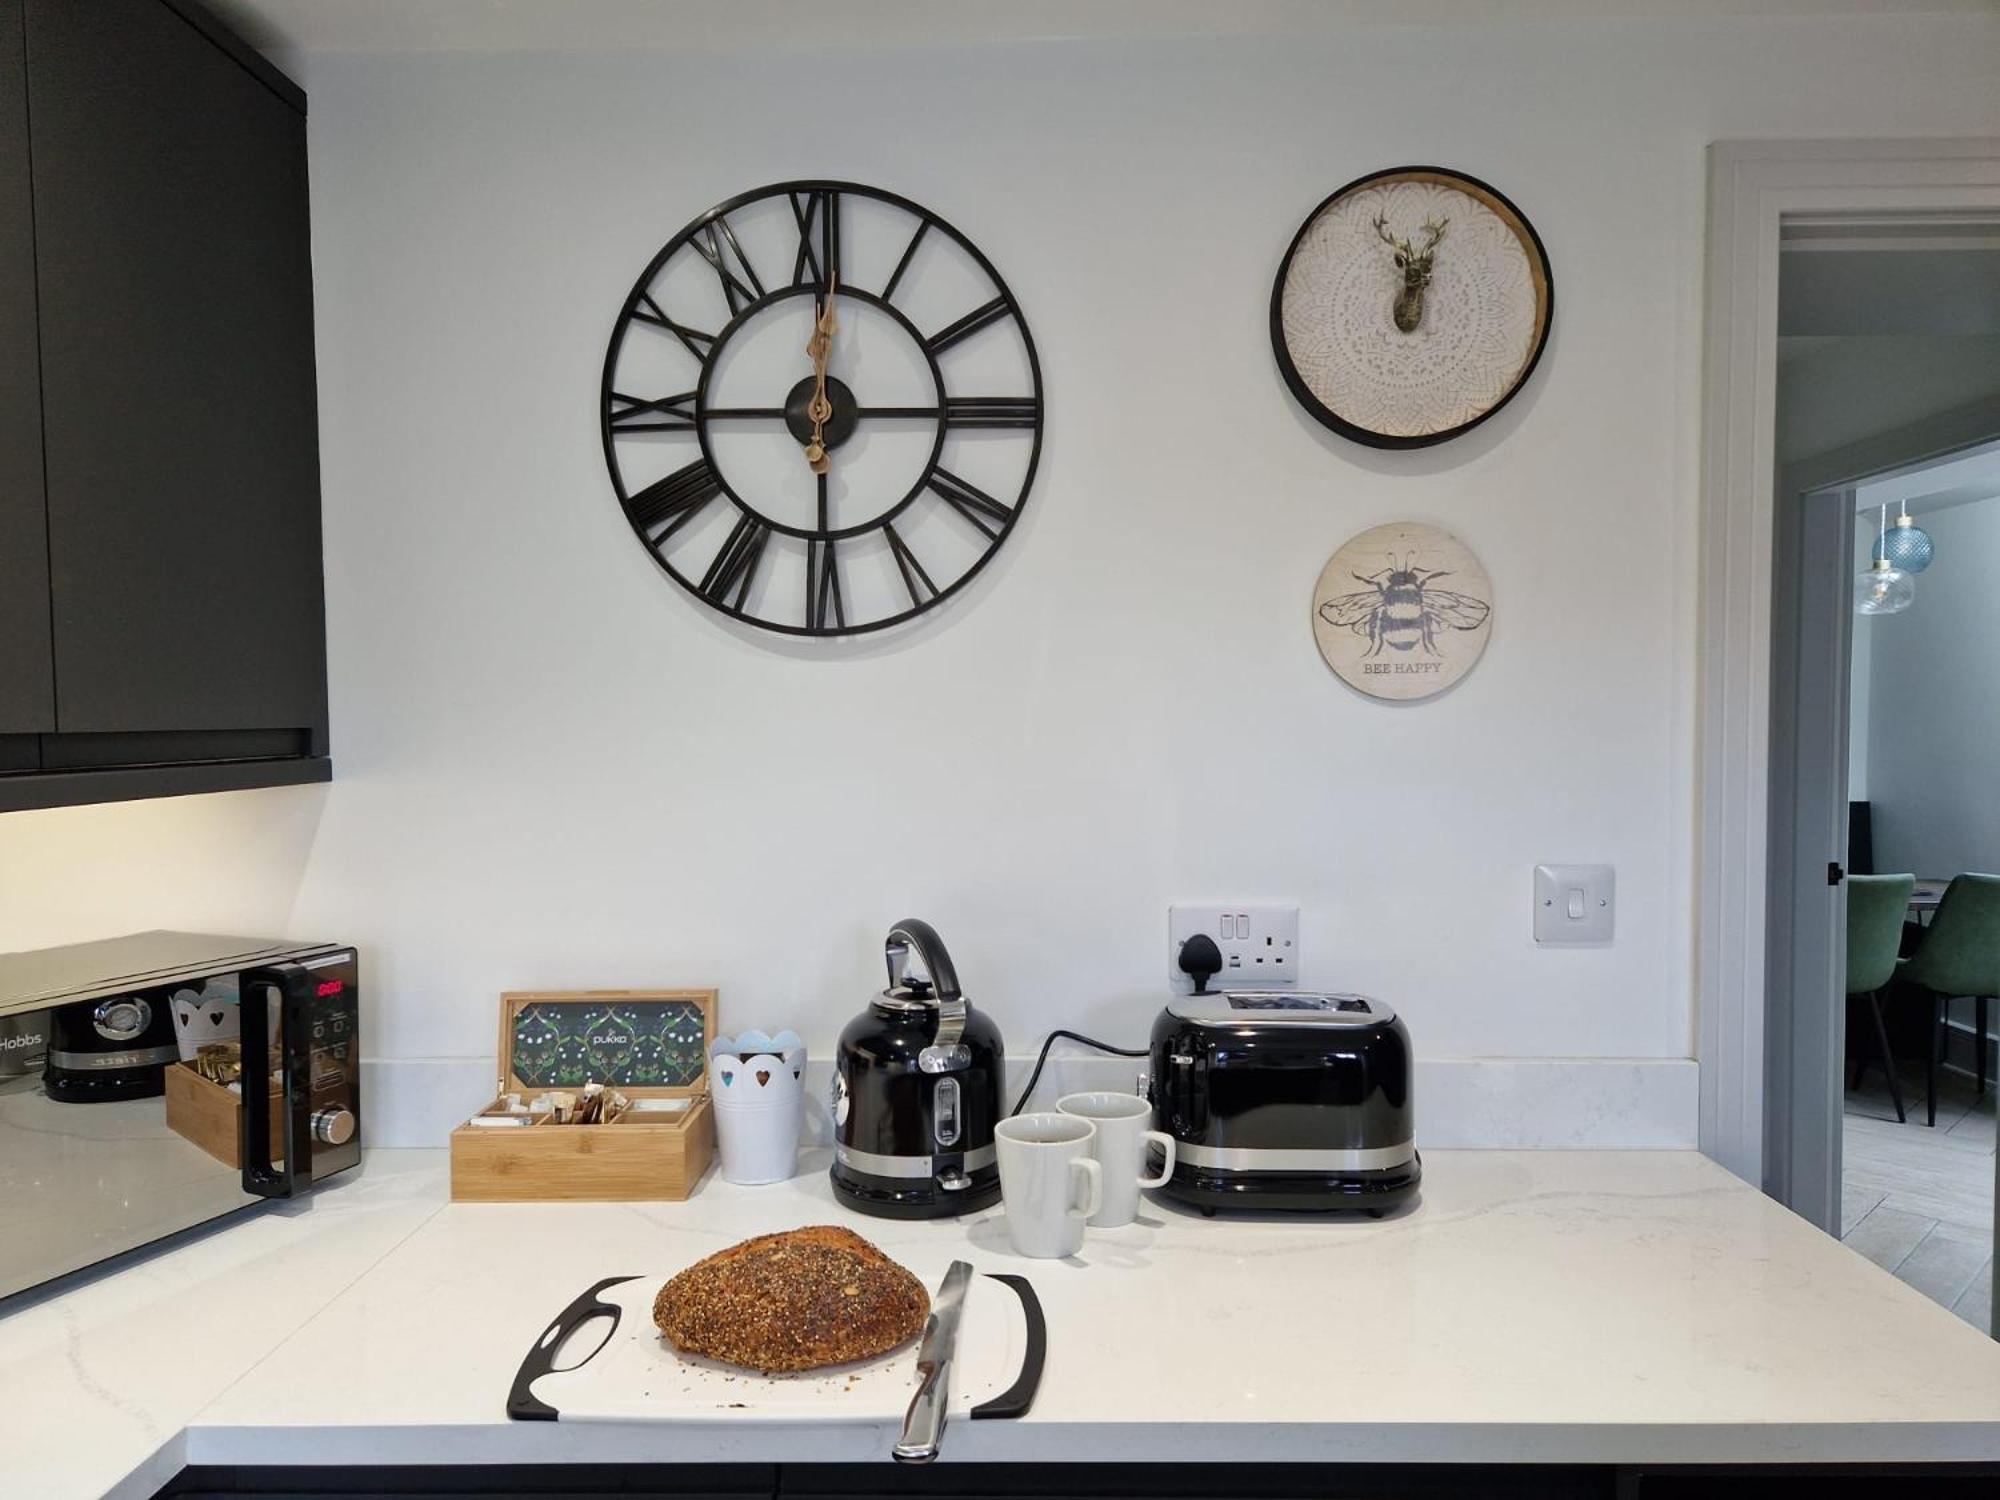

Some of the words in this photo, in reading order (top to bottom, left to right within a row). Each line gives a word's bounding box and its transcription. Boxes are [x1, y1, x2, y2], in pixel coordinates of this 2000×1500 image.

[686, 215, 767, 318] XI
[789, 190, 840, 290] XII
[628, 288, 718, 363] X
[925, 295, 1012, 356] II
[608, 390, 699, 433] IX
[944, 397, 1037, 428] III
[806, 538, 845, 630] VI
[883, 523, 942, 608] V
[1364, 663, 1391, 674] BEE
[1394, 662, 1442, 674] HAPPY
[593, 1035, 627, 1046] pukka
